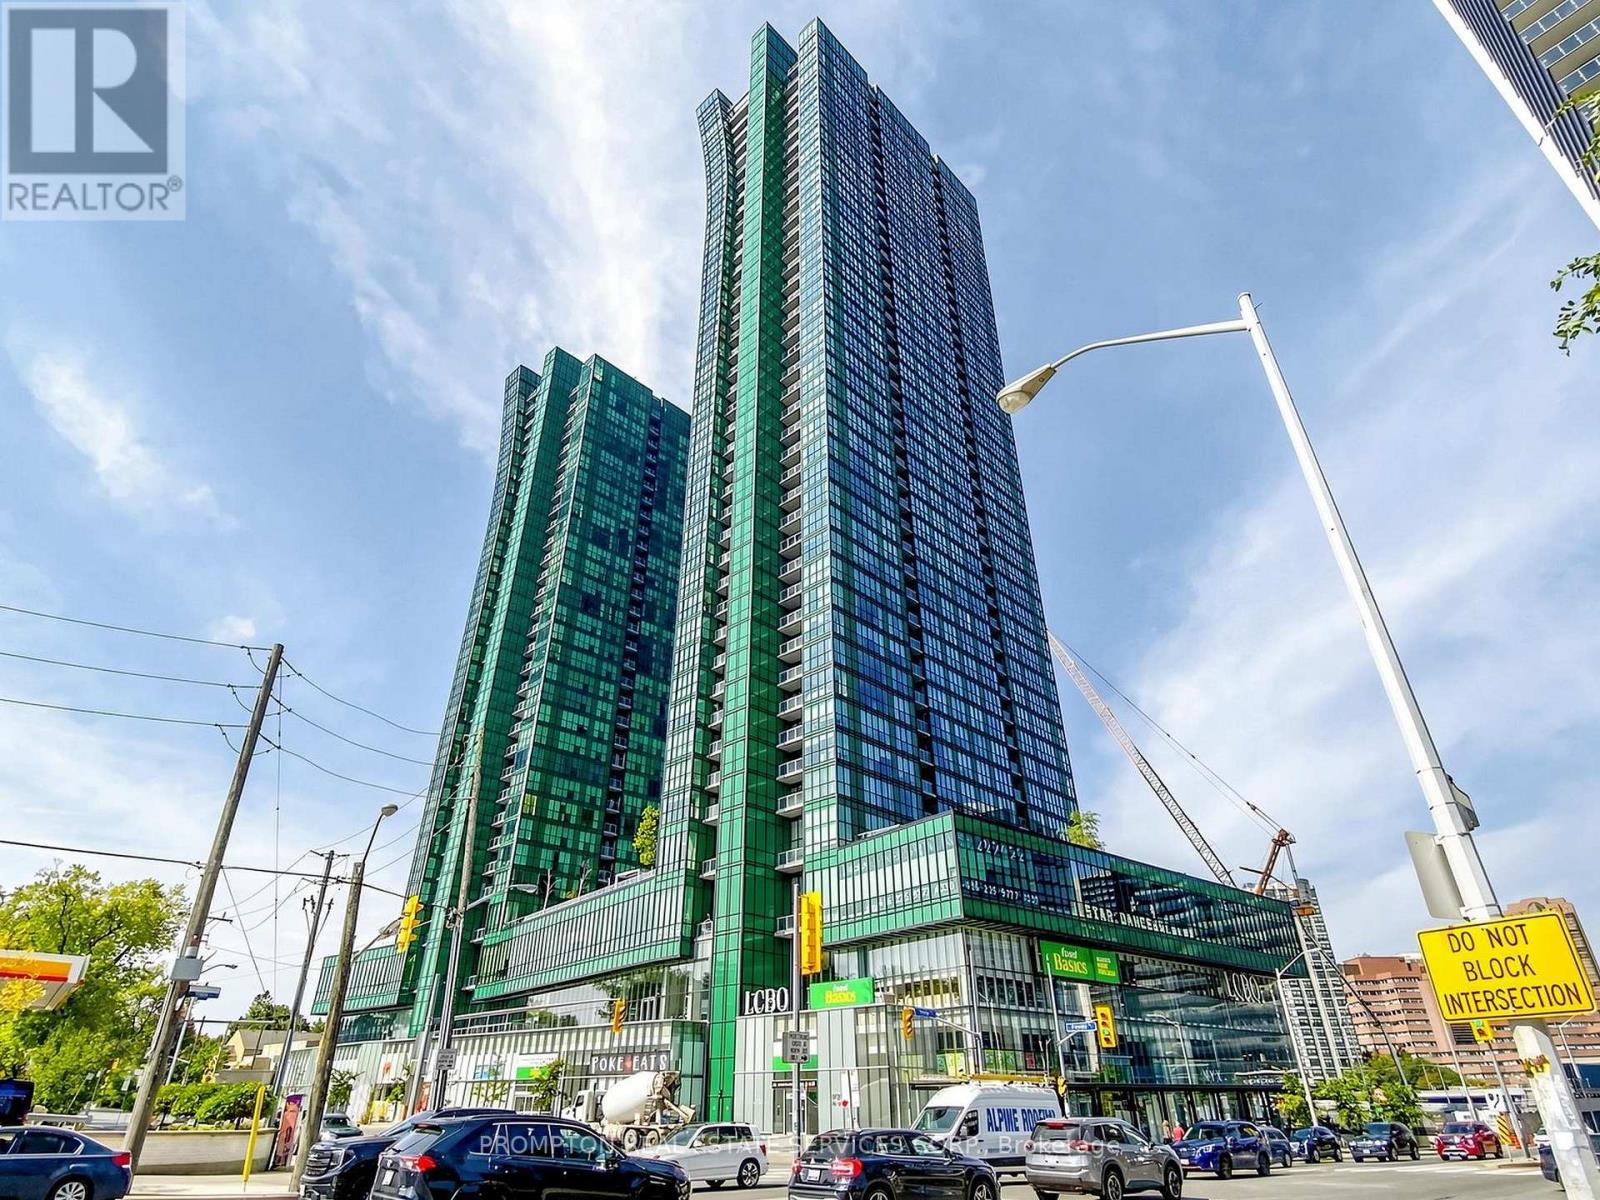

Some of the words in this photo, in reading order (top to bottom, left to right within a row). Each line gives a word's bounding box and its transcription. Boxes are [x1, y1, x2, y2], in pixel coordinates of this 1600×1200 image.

[1447, 931, 1475, 953] DO
[1488, 923, 1530, 948] NOT
[1053, 952, 1088, 975] Basics
[1463, 954, 1537, 982] BLOCK
[744, 986, 790, 1016] LCBO
[1444, 982, 1583, 1016] INTERSECTION
[592, 1056, 624, 1074] POKE
[632, 1054, 668, 1071] EATS
[986, 1107, 1020, 1132] ALPINE
